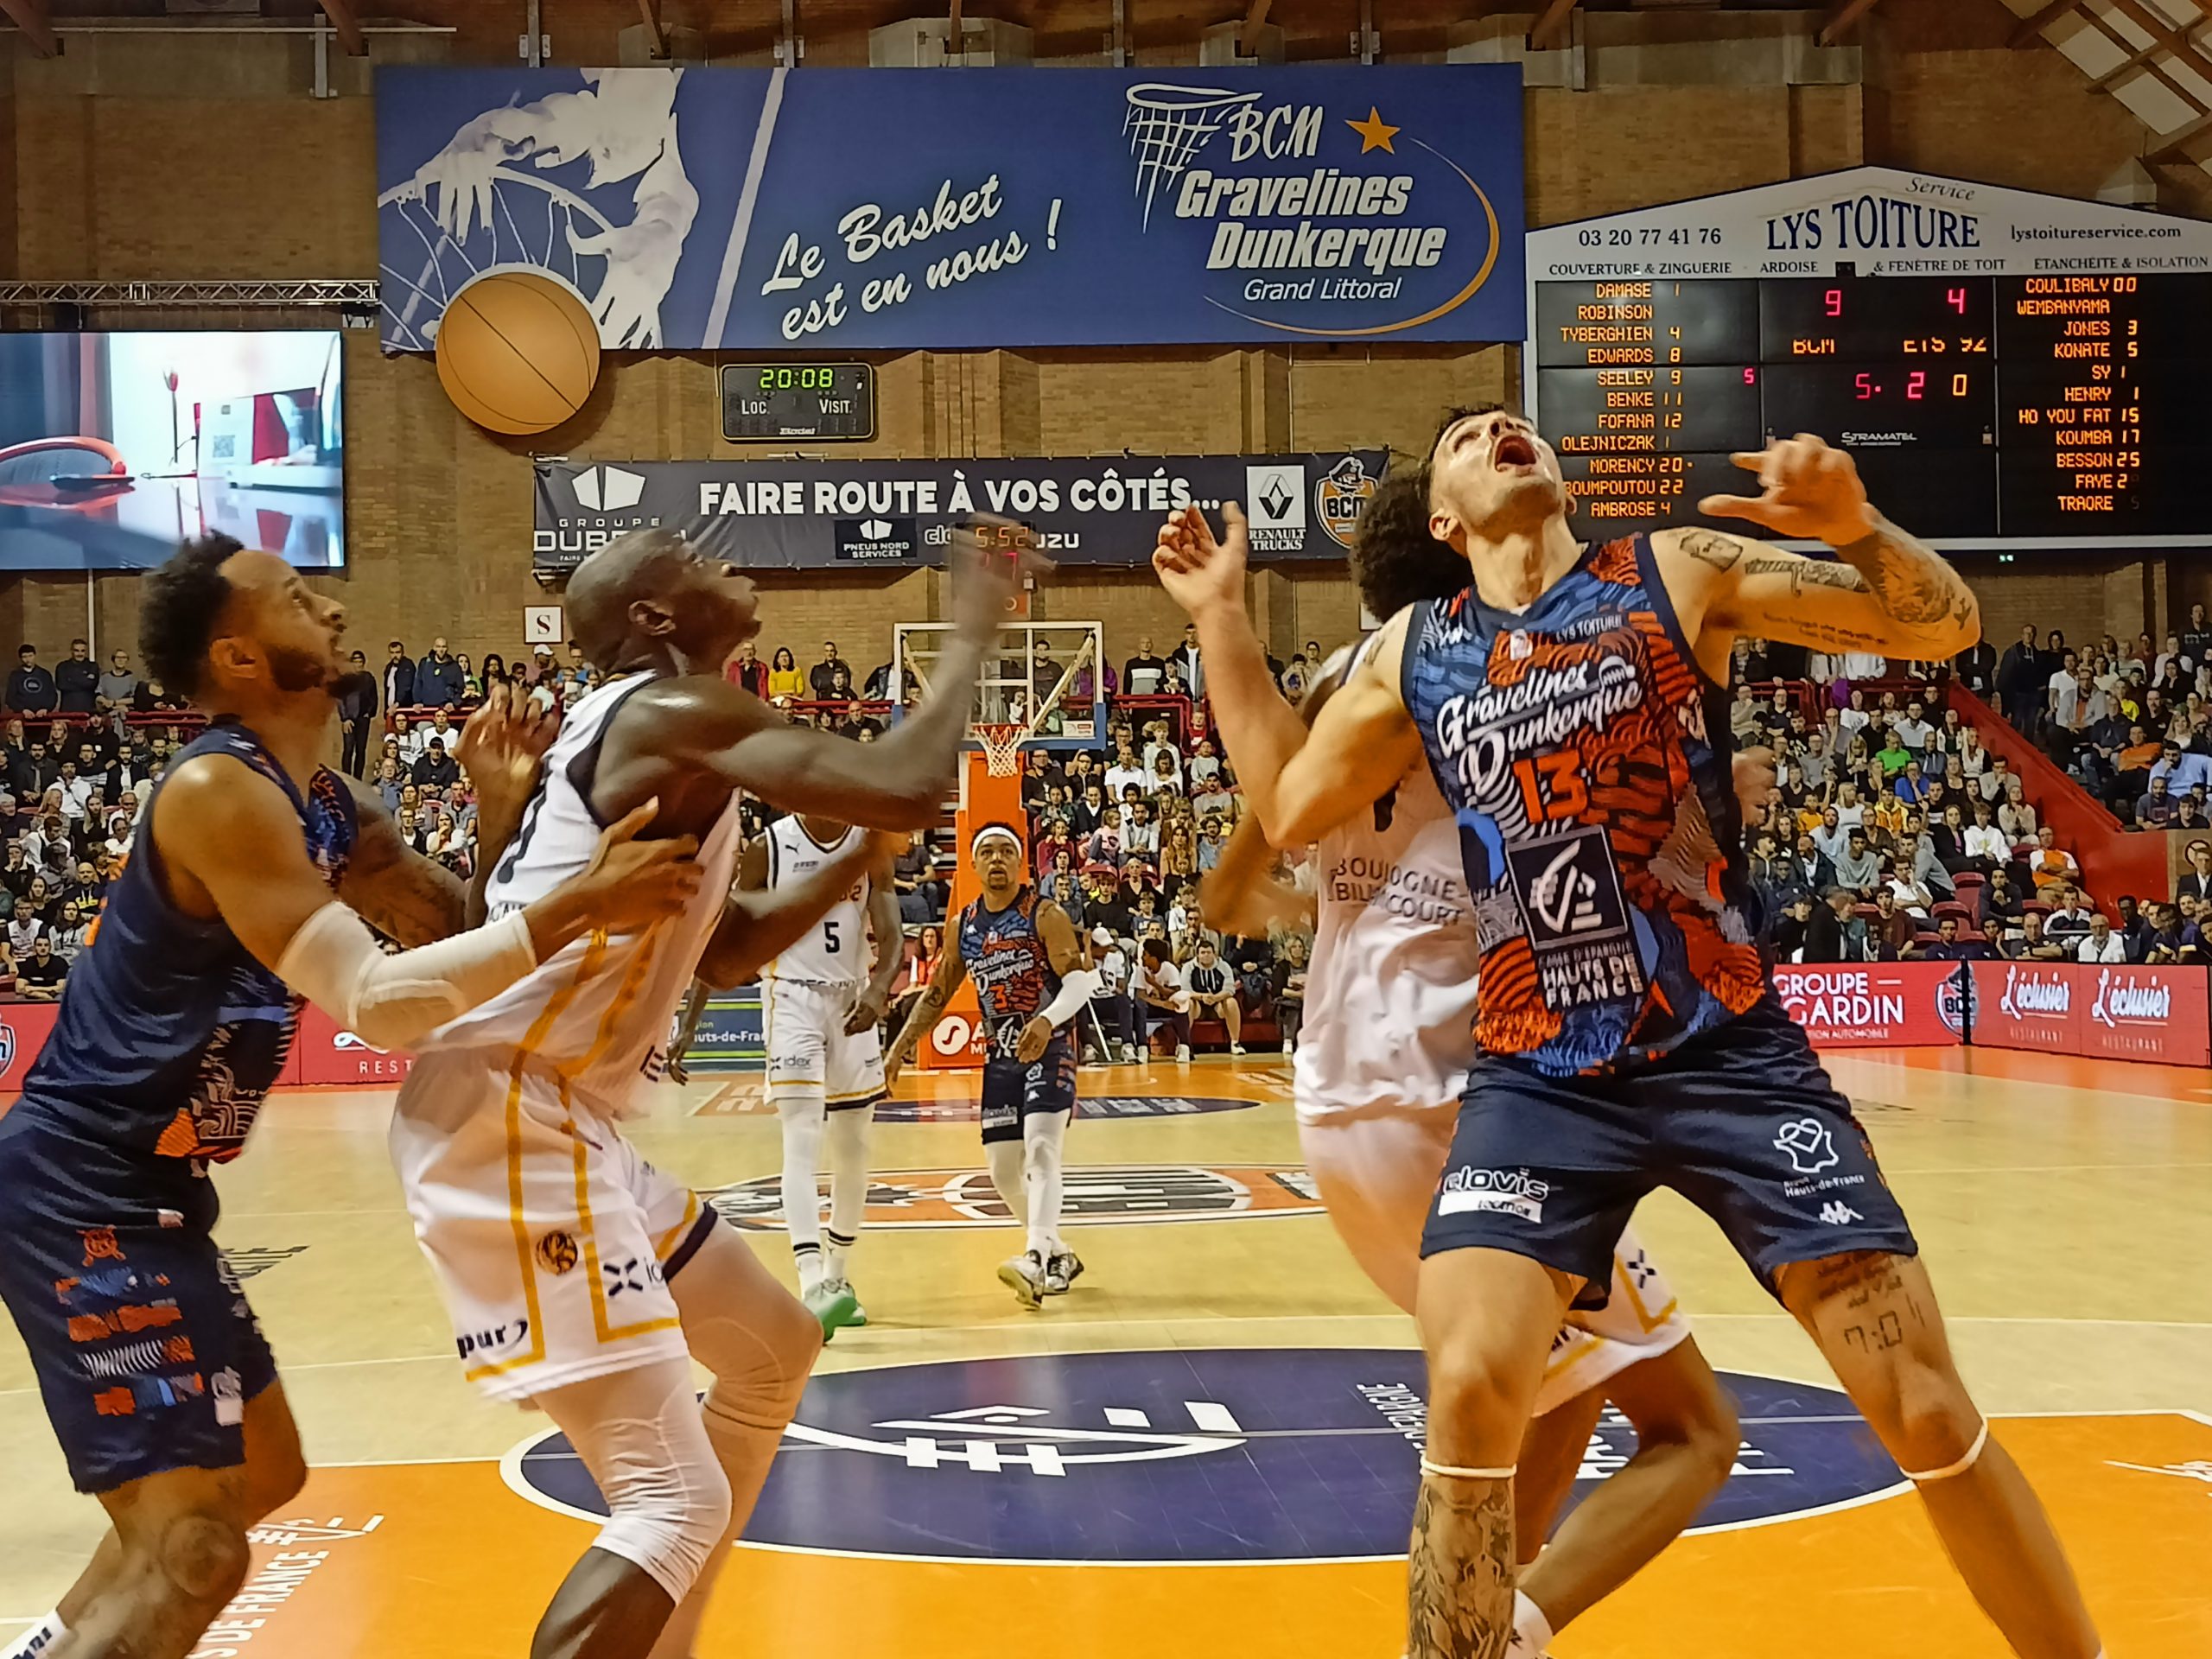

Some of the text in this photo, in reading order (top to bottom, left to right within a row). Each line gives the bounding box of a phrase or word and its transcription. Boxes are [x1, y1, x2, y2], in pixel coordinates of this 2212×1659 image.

[1228, 104, 1324, 162] BCM
[1175, 168, 1414, 218] Gravelines
[1905, 177, 1975, 200] Service
[1767, 194, 1980, 250] LYS TOITURE
[761, 174, 1003, 296] Le Basket
[1579, 228, 1721, 246] 03 20 77 41 76
[2011, 225, 2182, 241] lystoitureservice.com
[1206, 221, 1447, 275] Dunkerque
[782, 199, 1062, 340] est en nous !
[1549, 263, 1732, 275] COUVERTURE & ZINGUERIE
[1760, 262, 1819, 273] ARDOISE
[1873, 262, 1884, 272] &
[1953, 260, 1970, 270] DE
[1974, 259, 2005, 270] TOIT
[2121, 258, 2132, 269] &
[2137, 257, 2209, 268] ISOLATION
[1244, 277, 1402, 301] Grand Littoral
[1596, 283, 1651, 298] DAMASE
[2025, 277, 2108, 293] COULIBALY
[1825, 289, 1965, 315] 9 4
[2017, 300, 2111, 315] WEMBANYAMA
[1578, 305, 1653, 320] ROBINSON
[1560, 327, 1680, 342] TYBERGHIEN 4
[2063, 321, 2138, 335] JONES 3
[1587, 347, 1681, 363] EDWARDS 8
[2055, 342, 2138, 358] KONATE 5
[760, 368, 833, 388] 20:08
[1598, 370, 1681, 385] SEELEY 9
[1744, 368, 1754, 385] 5
[2092, 365, 2111, 379] SY
[1953, 374, 1967, 396] 0
[1607, 392, 1654, 407] BENKE
[2064, 387, 2112, 402] HENRY
[1599, 414, 1681, 429] FOFANA 12
[2018, 408, 2139, 423] HO YOU FAT 15
[1561, 435, 1656, 451] OLEJNICZAK
[1841, 432, 1917, 442] STRAMATEL
[2056, 429, 2140, 445] KOUMBA 17
[1590, 458, 1656, 474] MORENCY
[2056, 452, 2140, 467] BESSON 25
[1660, 480, 1684, 494] 22
[2075, 474, 2113, 488] FAYE
[700, 467, 1220, 515] FAIRE ROUTE À VOS CÔTÉS...
[1591, 502, 1656, 518] AMBROSE
[2057, 496, 2113, 512] TRAORE
[559, 518, 660, 527] GROUPE
[1249, 528, 1306, 540] RENAULT
[843, 543, 878, 551] PNEUS
[1251, 539, 1303, 550] TRUCKS
[852, 550, 902, 558] SERVICES
[537, 613, 550, 635] S
[1513, 749, 1587, 823] 13
[824, 922, 840, 953] 5
[1772, 973, 1868, 995] GROUPE
[989, 984, 1007, 1009] 3
[1783, 995, 1904, 1026] GARDIN
[225, 1550, 330, 1613] FRANCE
